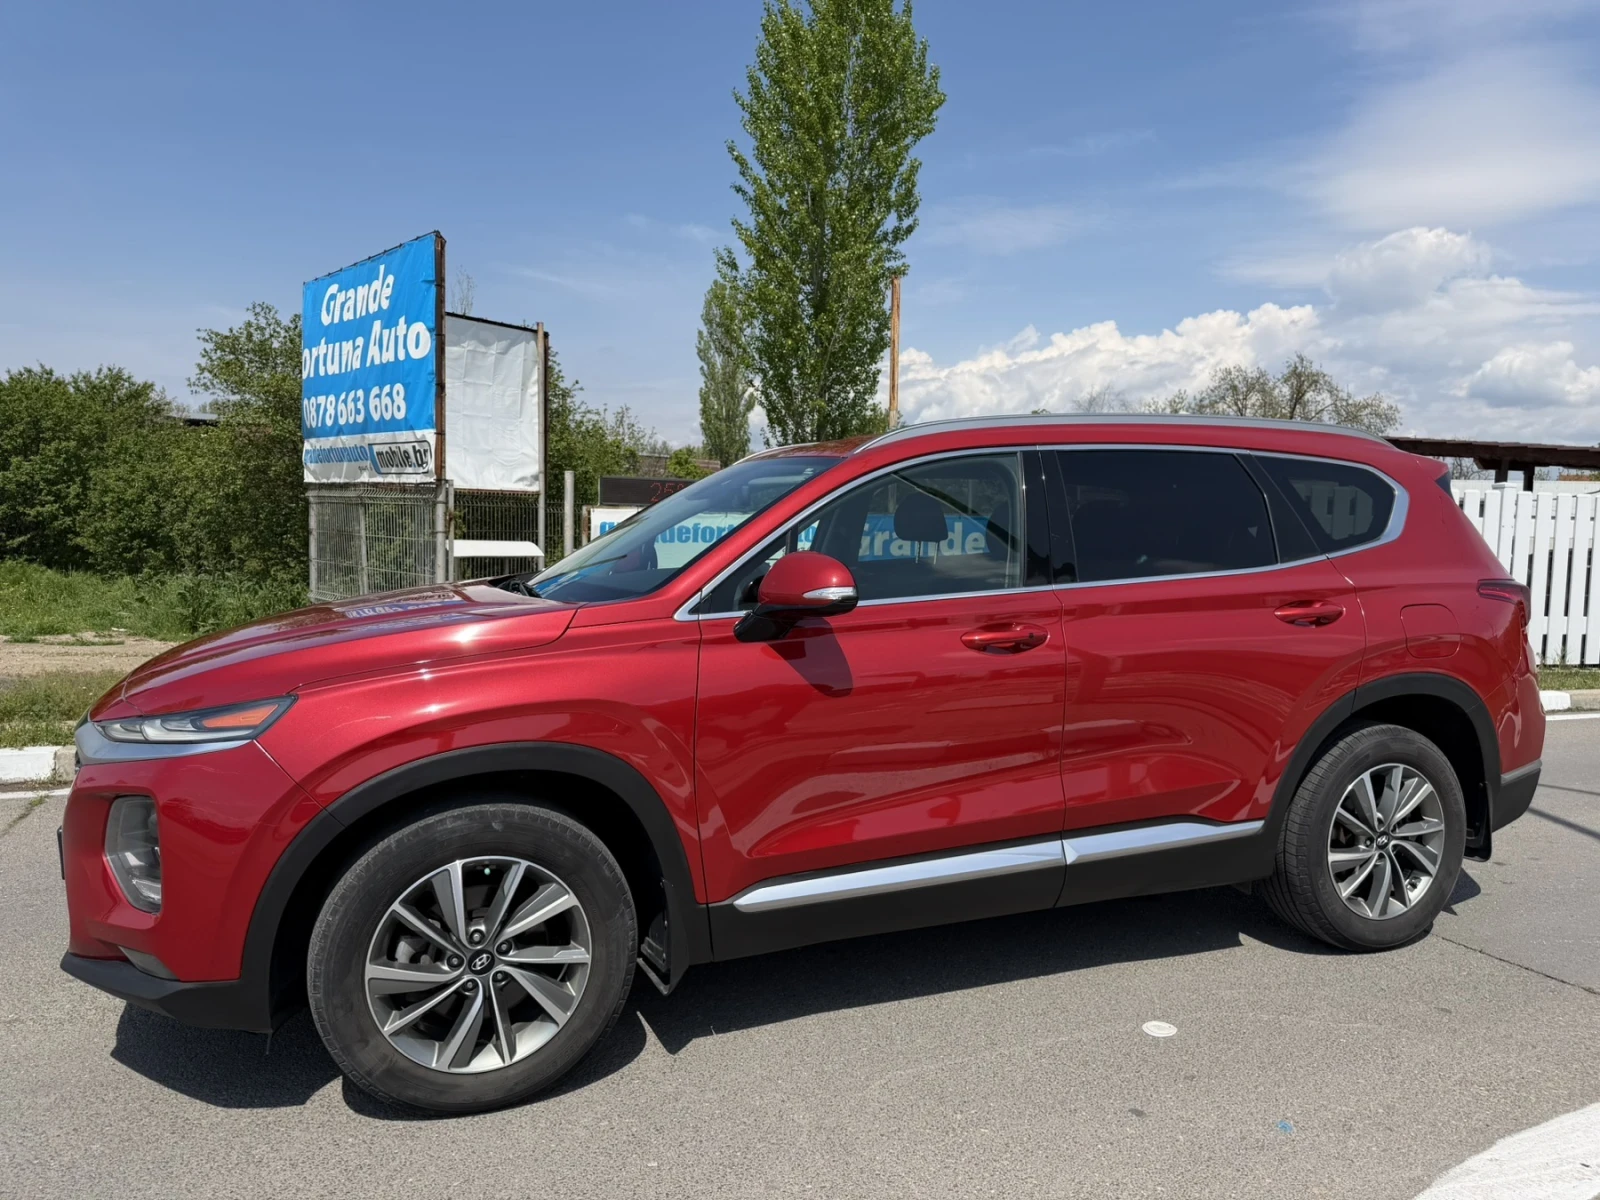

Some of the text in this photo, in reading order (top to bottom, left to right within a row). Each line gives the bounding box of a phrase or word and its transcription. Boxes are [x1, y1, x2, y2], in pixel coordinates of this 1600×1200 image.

[321, 264, 394, 326] Grande
[366, 315, 431, 367] Auto
[303, 383, 407, 428] 0878 663 668
